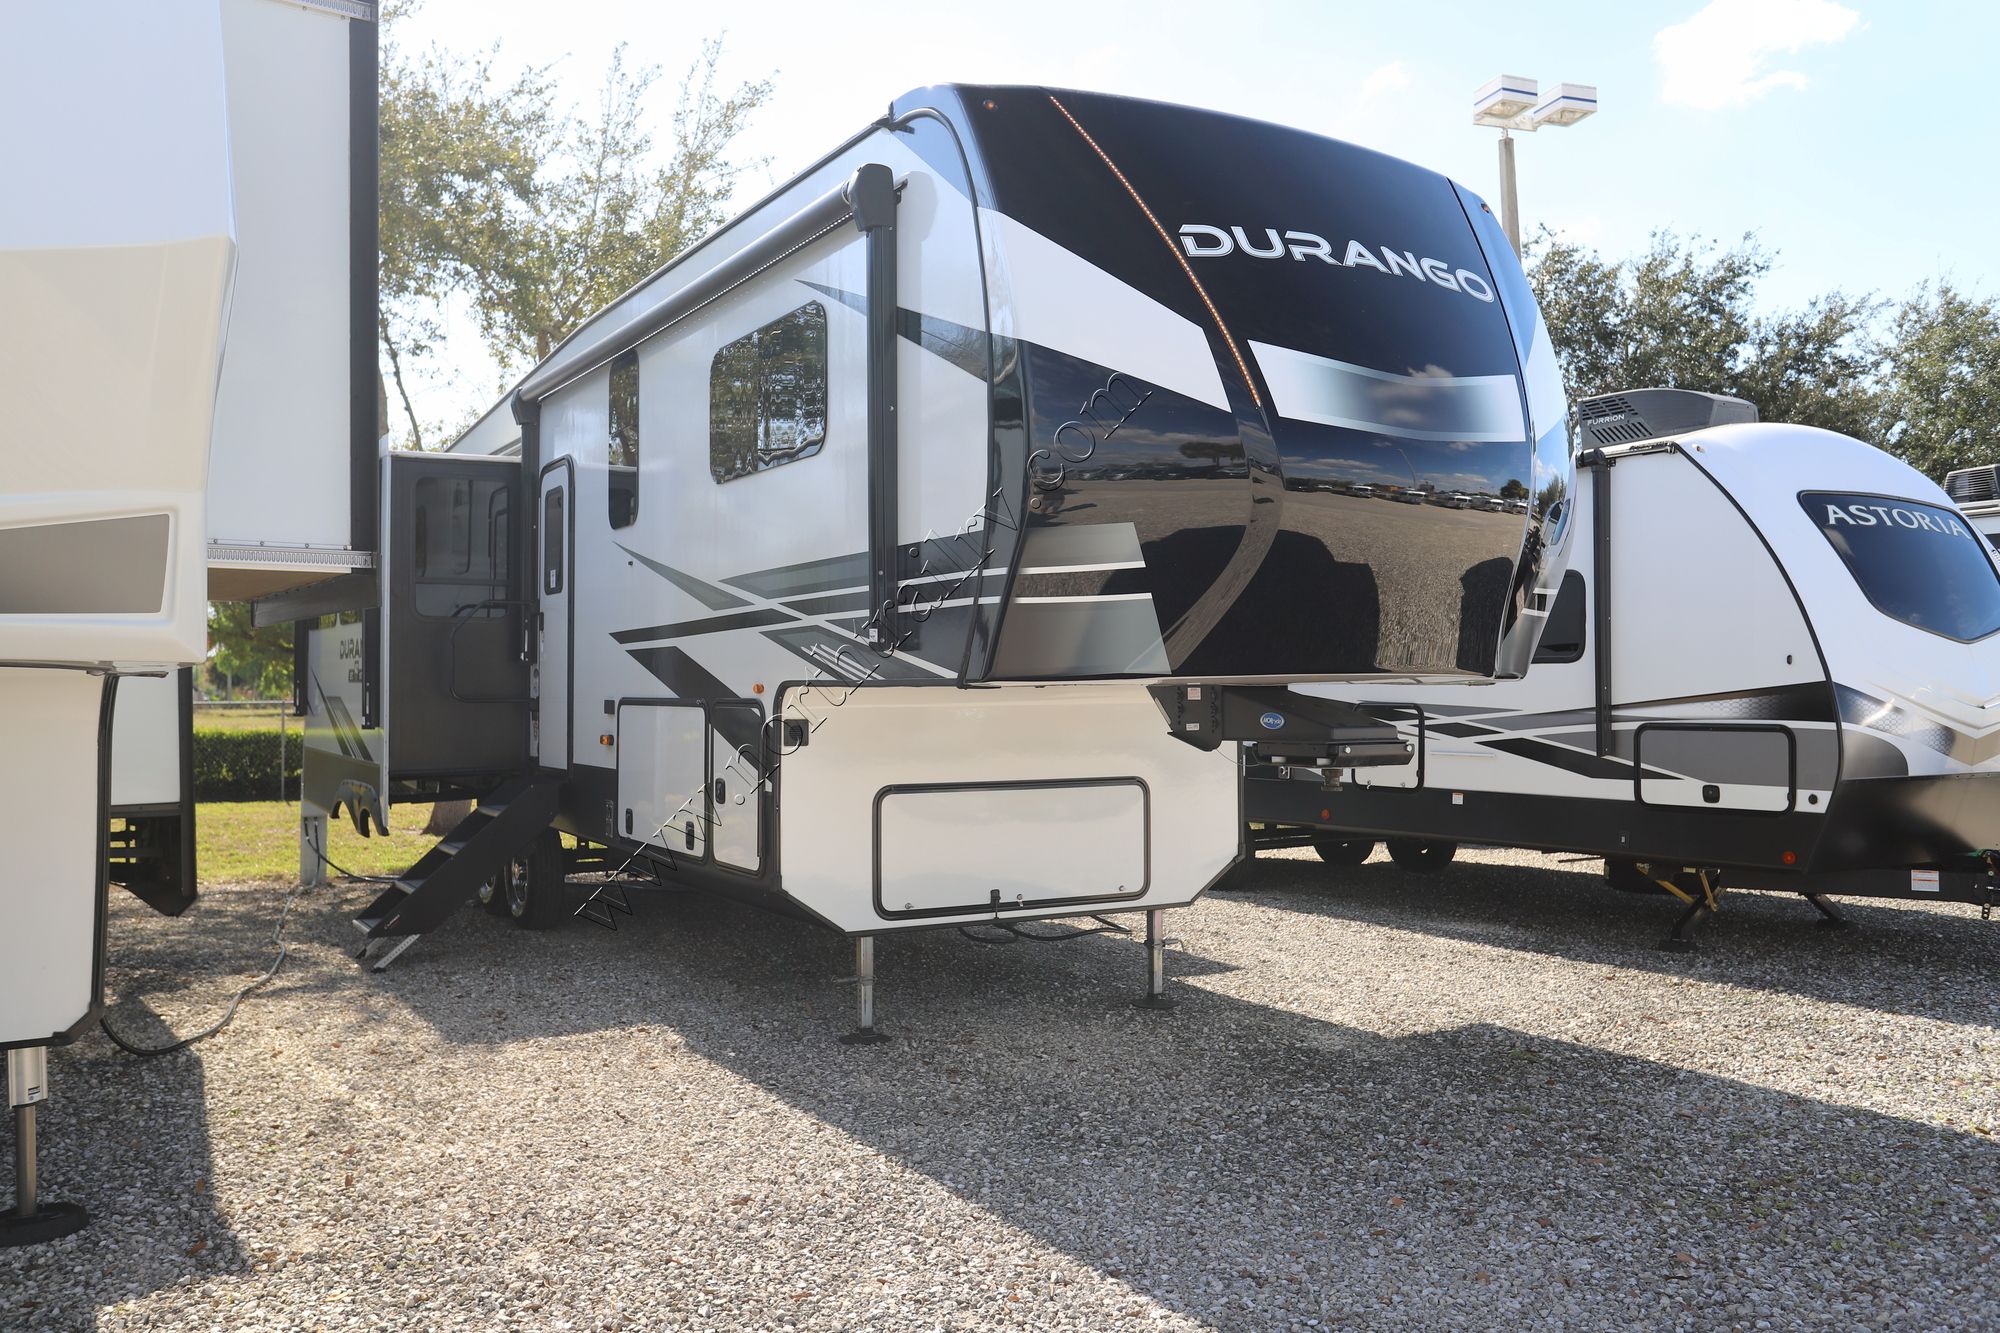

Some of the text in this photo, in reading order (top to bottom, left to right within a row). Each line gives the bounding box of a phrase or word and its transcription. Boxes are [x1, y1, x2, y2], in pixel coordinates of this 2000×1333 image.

[1179, 224, 1494, 302] DURANGO
[1587, 413, 1625, 426] FURRION
[1824, 504, 1974, 540] ASTORIA
